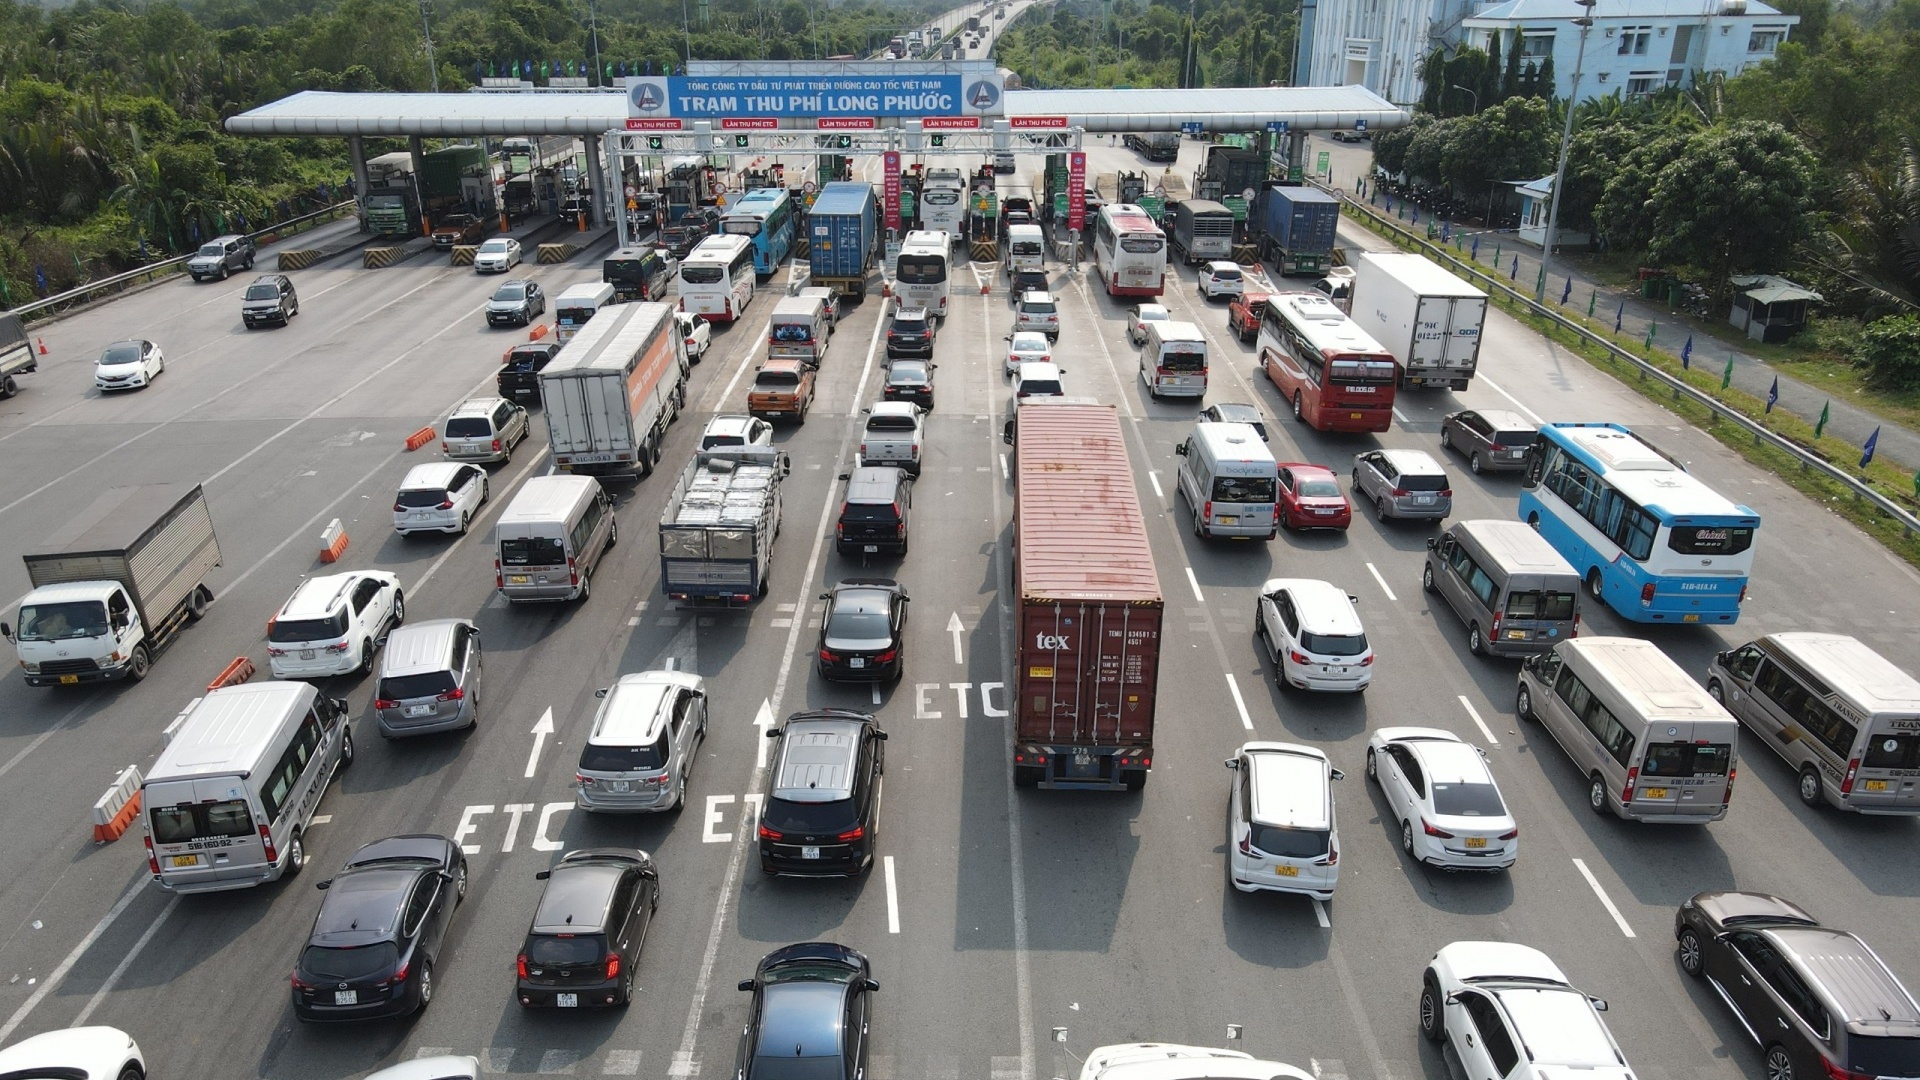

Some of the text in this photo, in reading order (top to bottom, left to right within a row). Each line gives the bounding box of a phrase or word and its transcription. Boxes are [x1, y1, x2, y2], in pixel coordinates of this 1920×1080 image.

[712, 80, 735, 91] CÔNG
[738, 82, 751, 91] TY
[864, 80, 880, 90] CAO
[902, 80, 920, 91] VIỆT
[922, 80, 941, 90] NAM
[679, 91, 952, 115] TRẠM THU PHÍ LONG PHƯỚC
[1036, 631, 1071, 650] tex
[915, 682, 1010, 719] ETC
[1833, 701, 1860, 725] TRANSIT
[453, 801, 576, 855] ETC
